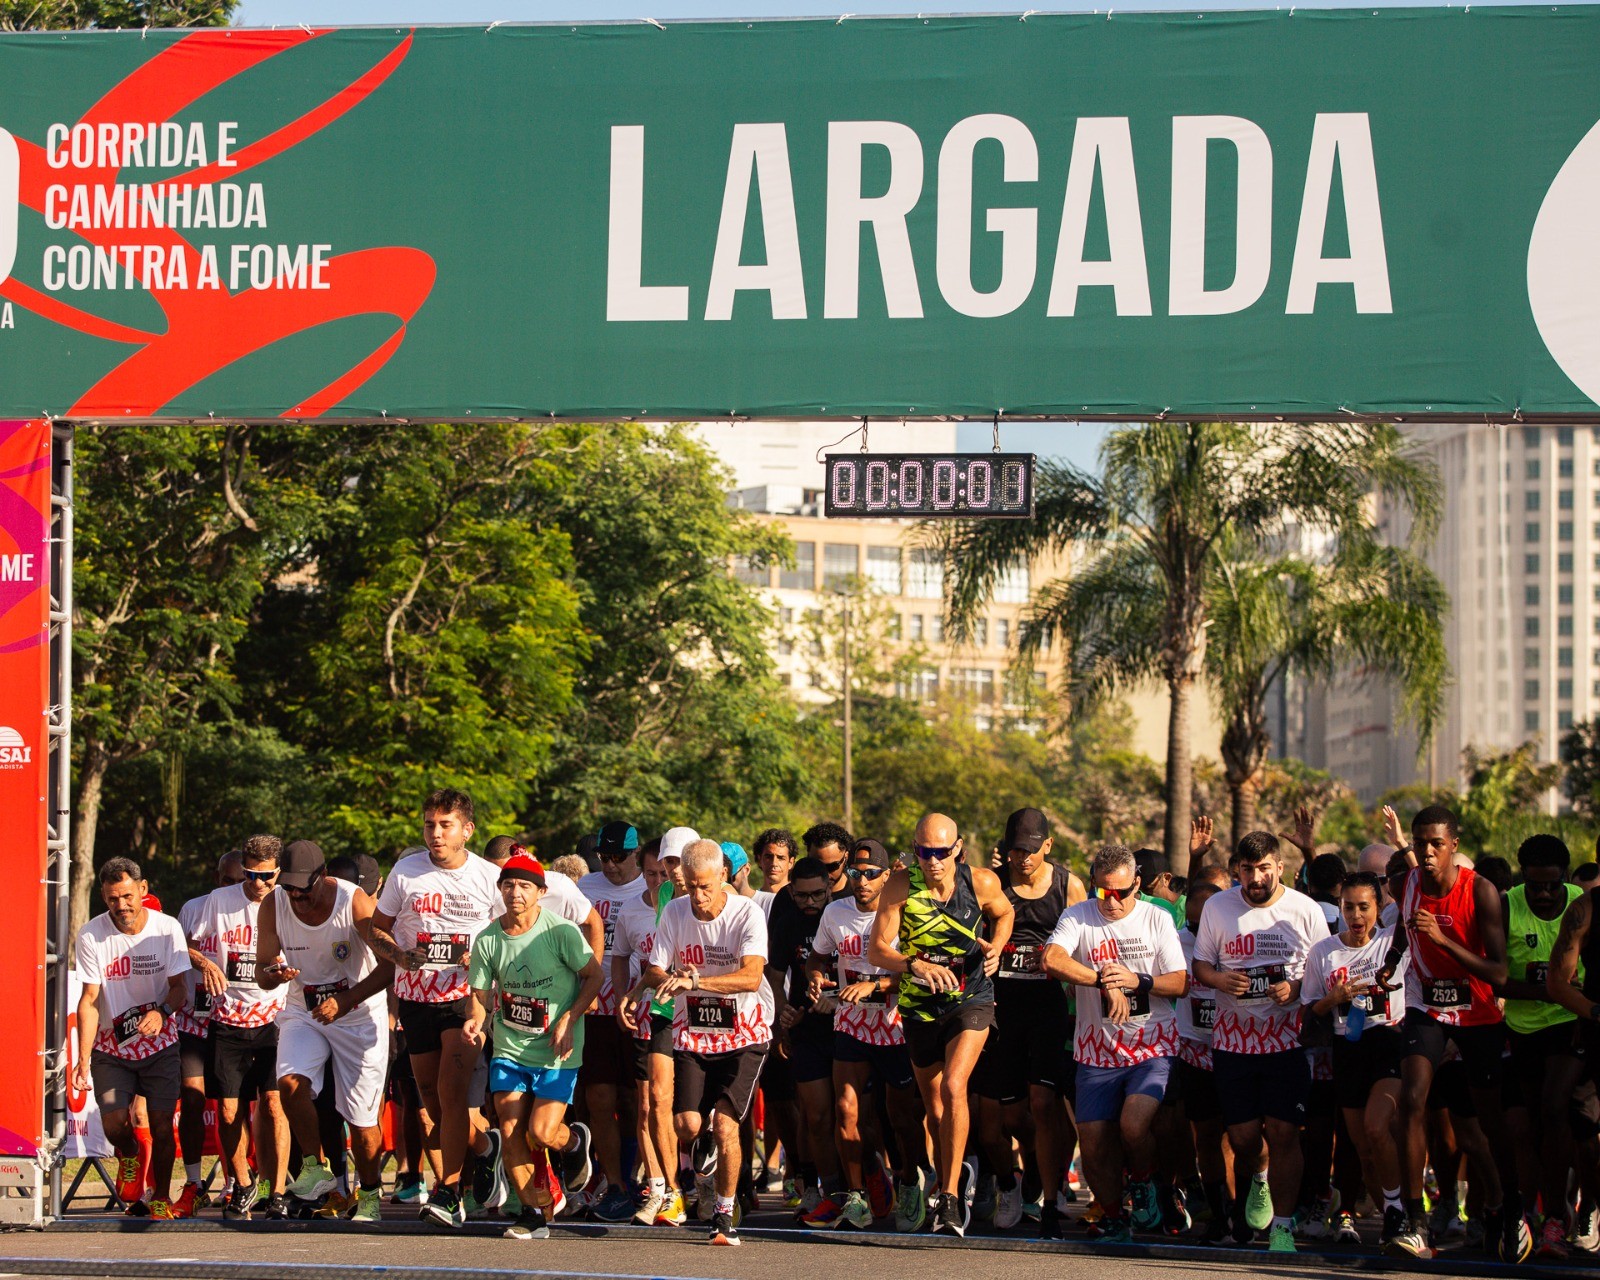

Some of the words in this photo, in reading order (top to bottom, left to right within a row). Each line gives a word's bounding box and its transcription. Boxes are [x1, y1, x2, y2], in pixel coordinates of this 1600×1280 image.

[46, 122, 208, 168] CORRIDA
[218, 121, 238, 167] E
[44, 183, 267, 229] CAMINHADA
[606, 112, 1393, 321] LARGADA
[42, 245, 188, 291] CONTRA
[196, 245, 220, 290] A
[229, 244, 332, 290] FOME
[1225, 933, 1255, 958] AÇÃO
[1256, 941, 1287, 949] CAMINHADA
[1257, 933, 1279, 941] CORRIDA
[428, 943, 452, 960] 2021
[1432, 987, 1458, 1003] 2523
[510, 1003, 532, 1022] 2265
[698, 1007, 723, 1023] 2124
